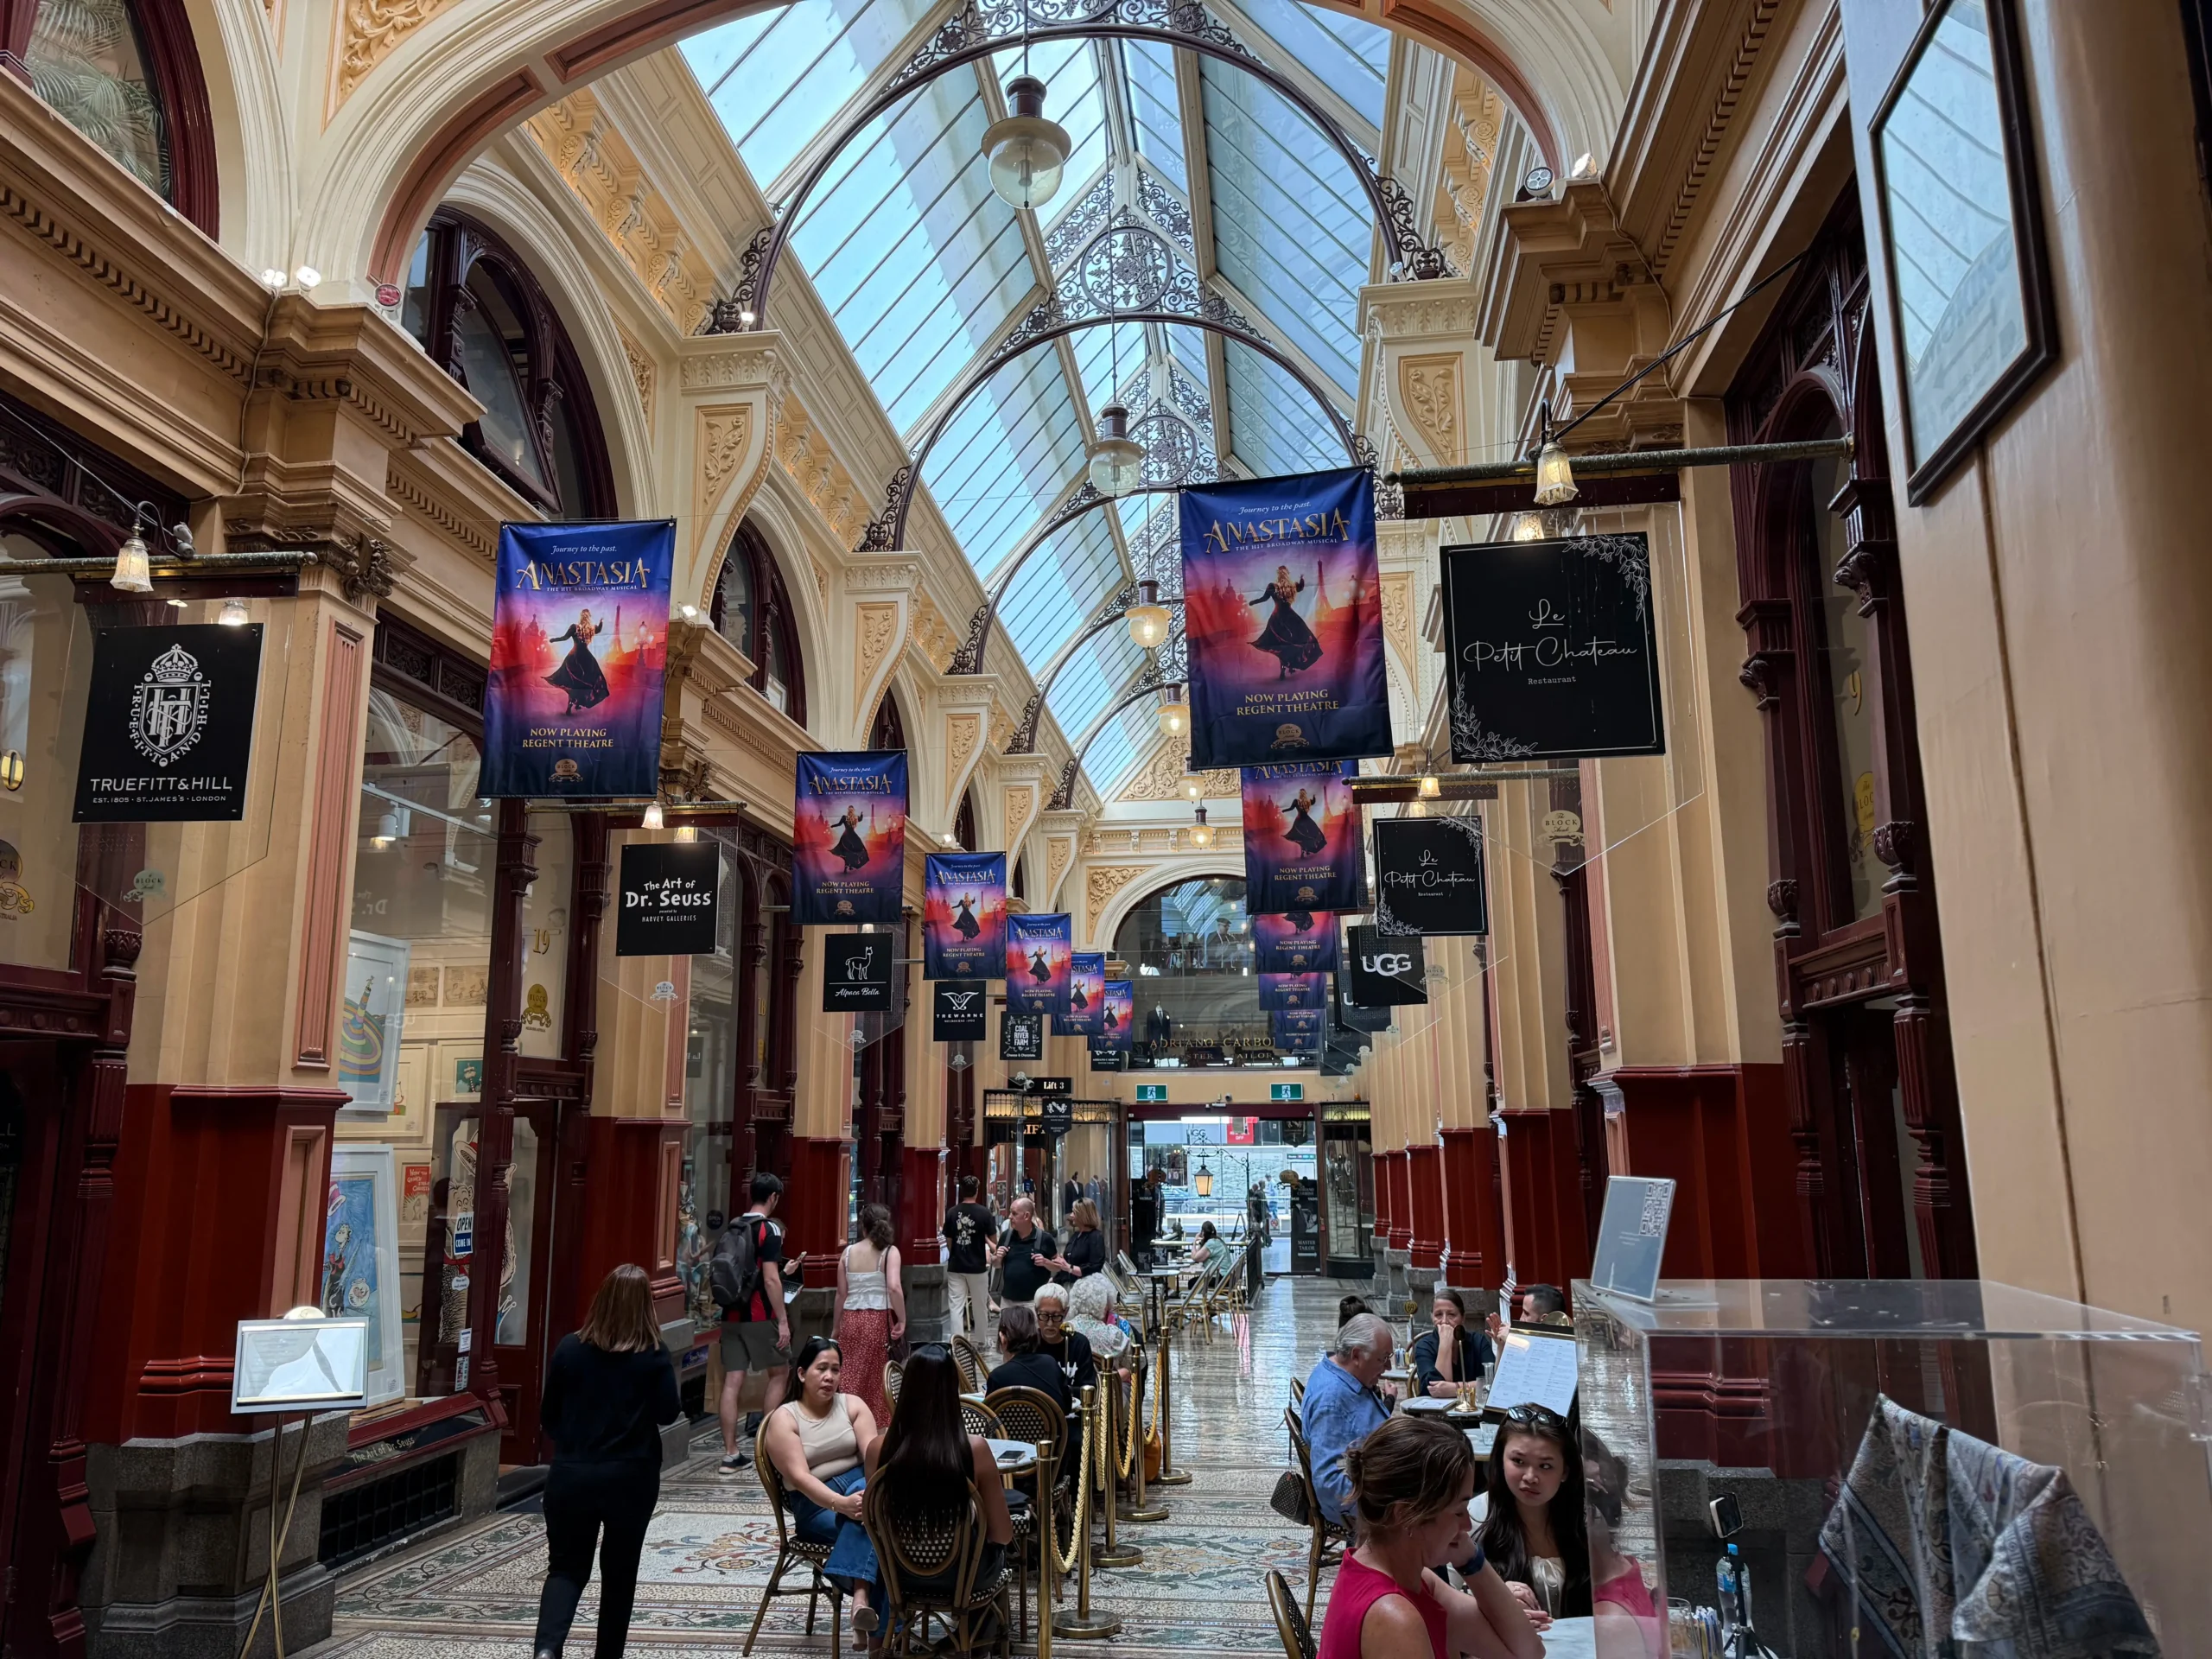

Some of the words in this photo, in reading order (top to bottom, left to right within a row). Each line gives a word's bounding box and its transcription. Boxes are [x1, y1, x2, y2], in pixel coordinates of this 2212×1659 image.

[1238, 505, 1270, 515] Journey
[1294, 501, 1312, 512] past.
[1203, 507, 1350, 554] ANASTASIA
[551, 544, 579, 555] Journey
[601, 545, 617, 555] past.
[1267, 540, 1306, 549] BROADWAY
[515, 557, 651, 591] ANASTASIA
[1529, 598, 1565, 629] Le
[1463, 640, 1535, 672] Petit
[1535, 636, 1637, 666] Chateau
[1528, 676, 1576, 685] Restaurant
[1245, 693, 1274, 703] NOW
[1277, 689, 1329, 702] PLAYING
[1236, 705, 1283, 716] REGENT
[1285, 700, 1339, 713] THEATRE
[530, 728, 557, 736] NOW
[560, 728, 607, 737] PLAYING
[522, 739, 564, 747] REGENT
[566, 739, 613, 748] THEATRE
[90, 777, 232, 792] TRUEFITT&HILL
[808, 772, 893, 795] ANASTASIA
[1418, 849, 1438, 867] Le
[935, 868, 996, 885] ANASTASIA
[1384, 870, 1422, 888] Petit
[1422, 869, 1475, 887] Chateau
[643, 880, 660, 892] The
[662, 877, 682, 889] Art
[685, 880, 696, 889] of
[626, 891, 652, 907] Dr.
[1016, 927, 1064, 939] ANASTASIA
[533, 928, 550, 956] 19
[1071, 963, 1098, 974] STASIA
[1362, 953, 1412, 976] UGG
[835, 988, 860, 998] Alpaca
[861, 987, 880, 995] Bella
[1104, 988, 1127, 998] STASIA
[1150, 1037, 1214, 1048] ADRIANO
[1043, 1081, 1058, 1090] Lift
[456, 1217, 473, 1231] OPEN
[455, 1238, 466, 1248] COME
[351, 1452, 365, 1464] The
[366, 1446, 378, 1459] Art
[378, 1444, 386, 1455] of
[387, 1442, 397, 1452] Dr.
[397, 1436, 416, 1449] Seuss
